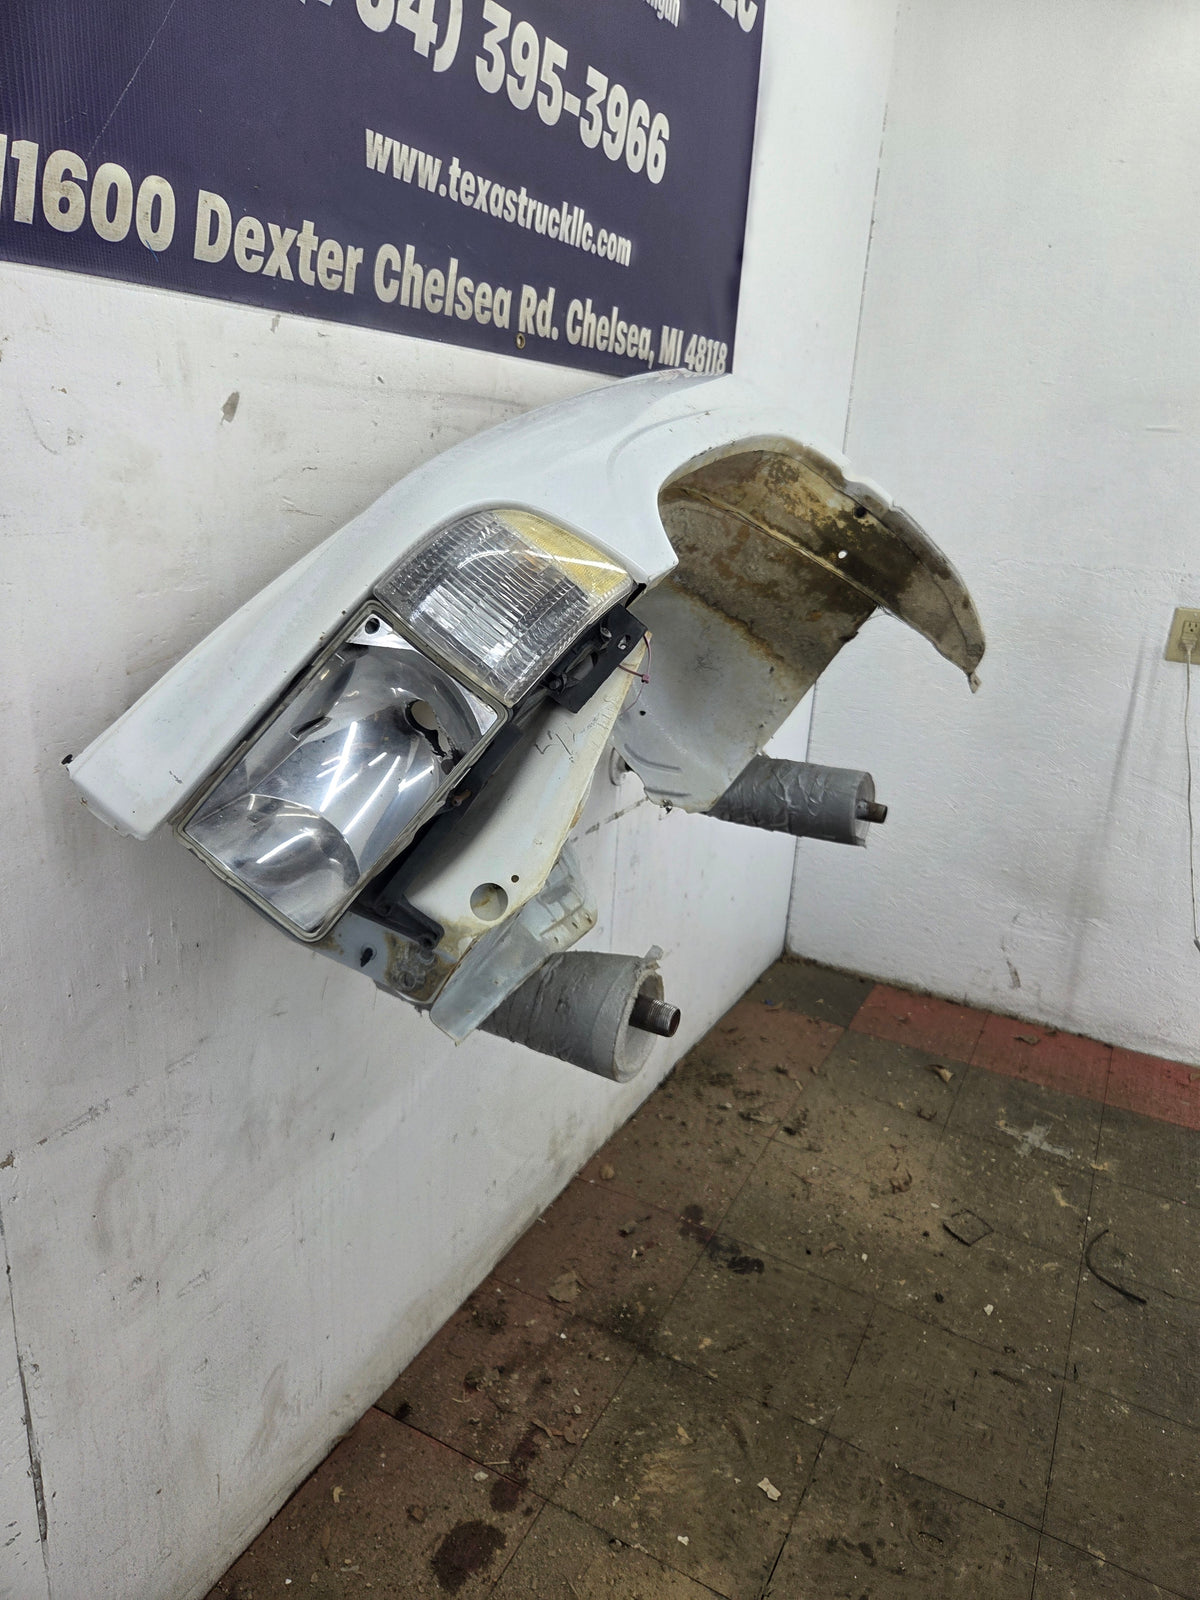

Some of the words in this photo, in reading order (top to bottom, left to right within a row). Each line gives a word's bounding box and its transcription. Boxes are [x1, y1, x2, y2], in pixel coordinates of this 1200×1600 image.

[475, 0, 670, 184] 395-3966
[193, 189, 364, 295] Dexter
[373, 243, 513, 329] Chelsea
[518, 284, 560, 341] Rd.
[566, 297, 655, 370] Chelsea,
[658, 325, 684, 368] MI
[683, 333, 728, 375] 48118
[365, 128, 632, 267] www.texastruckllc.com
